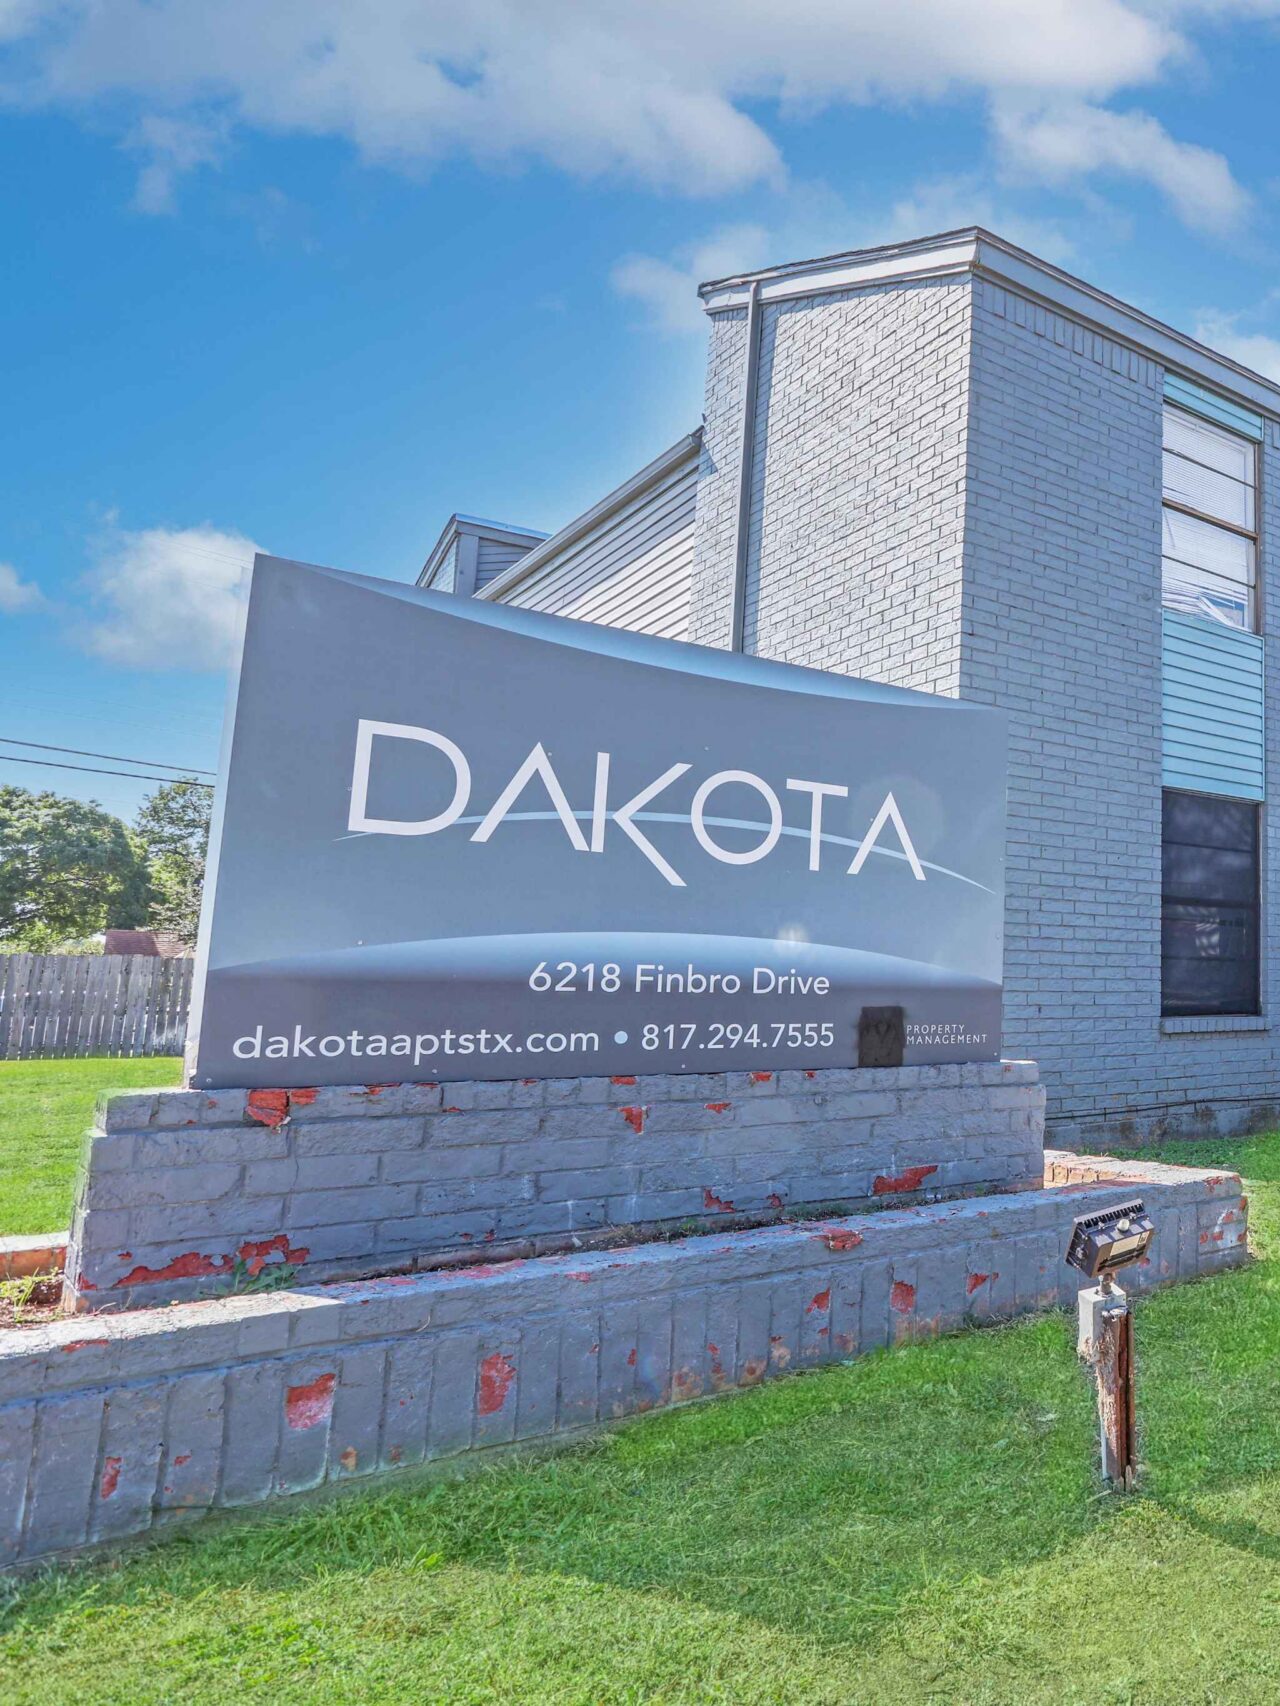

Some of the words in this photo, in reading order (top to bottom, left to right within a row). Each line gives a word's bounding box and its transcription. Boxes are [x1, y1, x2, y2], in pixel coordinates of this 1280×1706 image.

[347, 719, 926, 887] DAKOTA
[528, 961, 621, 993] 6218
[635, 963, 741, 994] Finbro
[752, 967, 830, 995] Drive
[232, 1024, 600, 1066] dakotaaptstx.com
[641, 1023, 834, 1051] 817.294.7555
[906, 1024, 965, 1035] PROPERTY
[906, 1034, 988, 1045] MANAGEMENT
